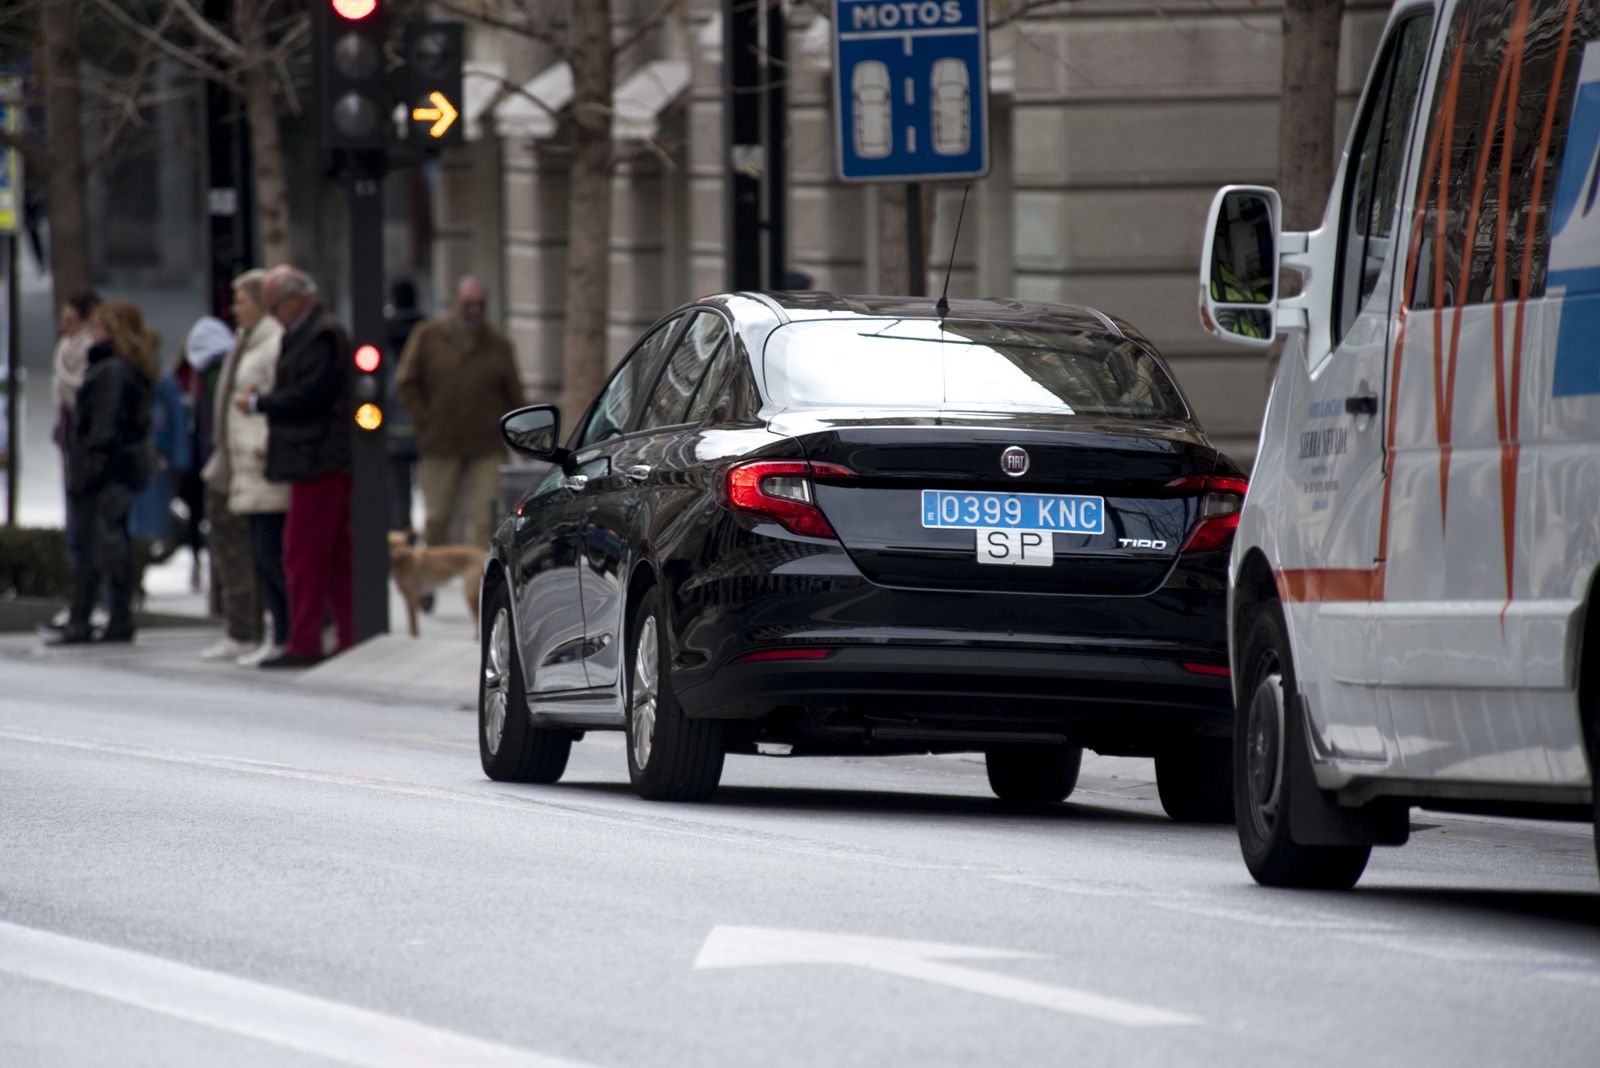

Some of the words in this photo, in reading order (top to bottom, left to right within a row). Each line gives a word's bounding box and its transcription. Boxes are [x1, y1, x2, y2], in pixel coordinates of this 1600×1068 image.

[852, 1, 963, 29] MOTOS
[1008, 455, 1025, 469] FIAT
[927, 511, 935, 521] E
[942, 495, 1022, 525] 0399
[1039, 499, 1097, 529] KNC
[1119, 538, 1167, 550] TIPO
